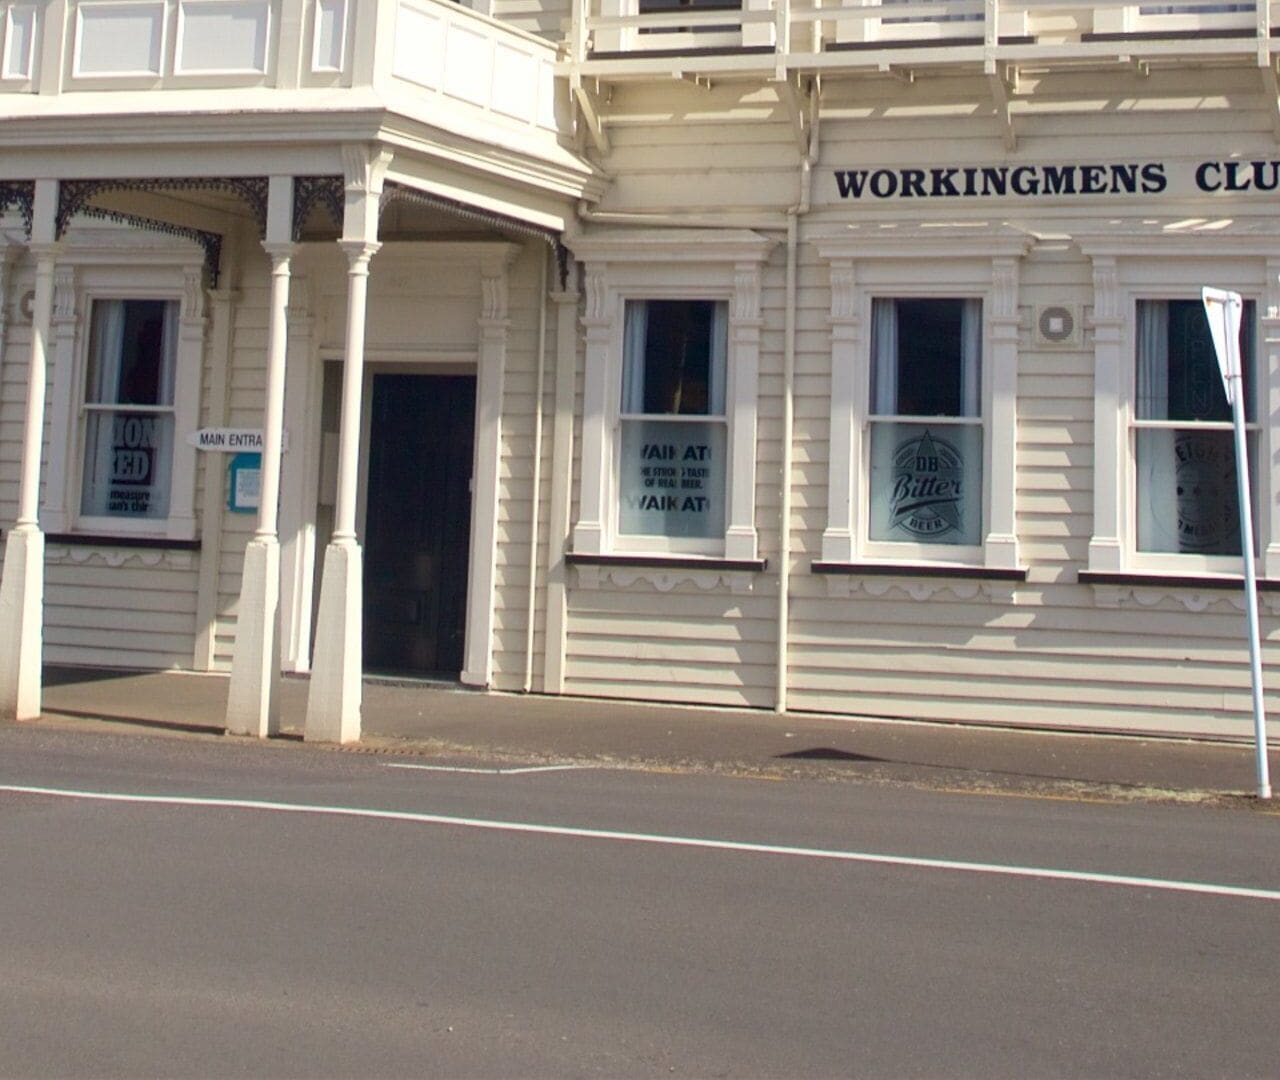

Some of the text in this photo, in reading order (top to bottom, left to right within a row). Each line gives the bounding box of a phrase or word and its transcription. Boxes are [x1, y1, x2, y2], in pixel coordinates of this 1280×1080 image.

[834, 162, 1167, 199] WORKINGMENS
[200, 433, 263, 447] MAIN ENTRA
[916, 455, 938, 472] DB
[644, 478, 654, 488] OF
[893, 473, 961, 501] Bitter
[910, 518, 943, 531] BEER
